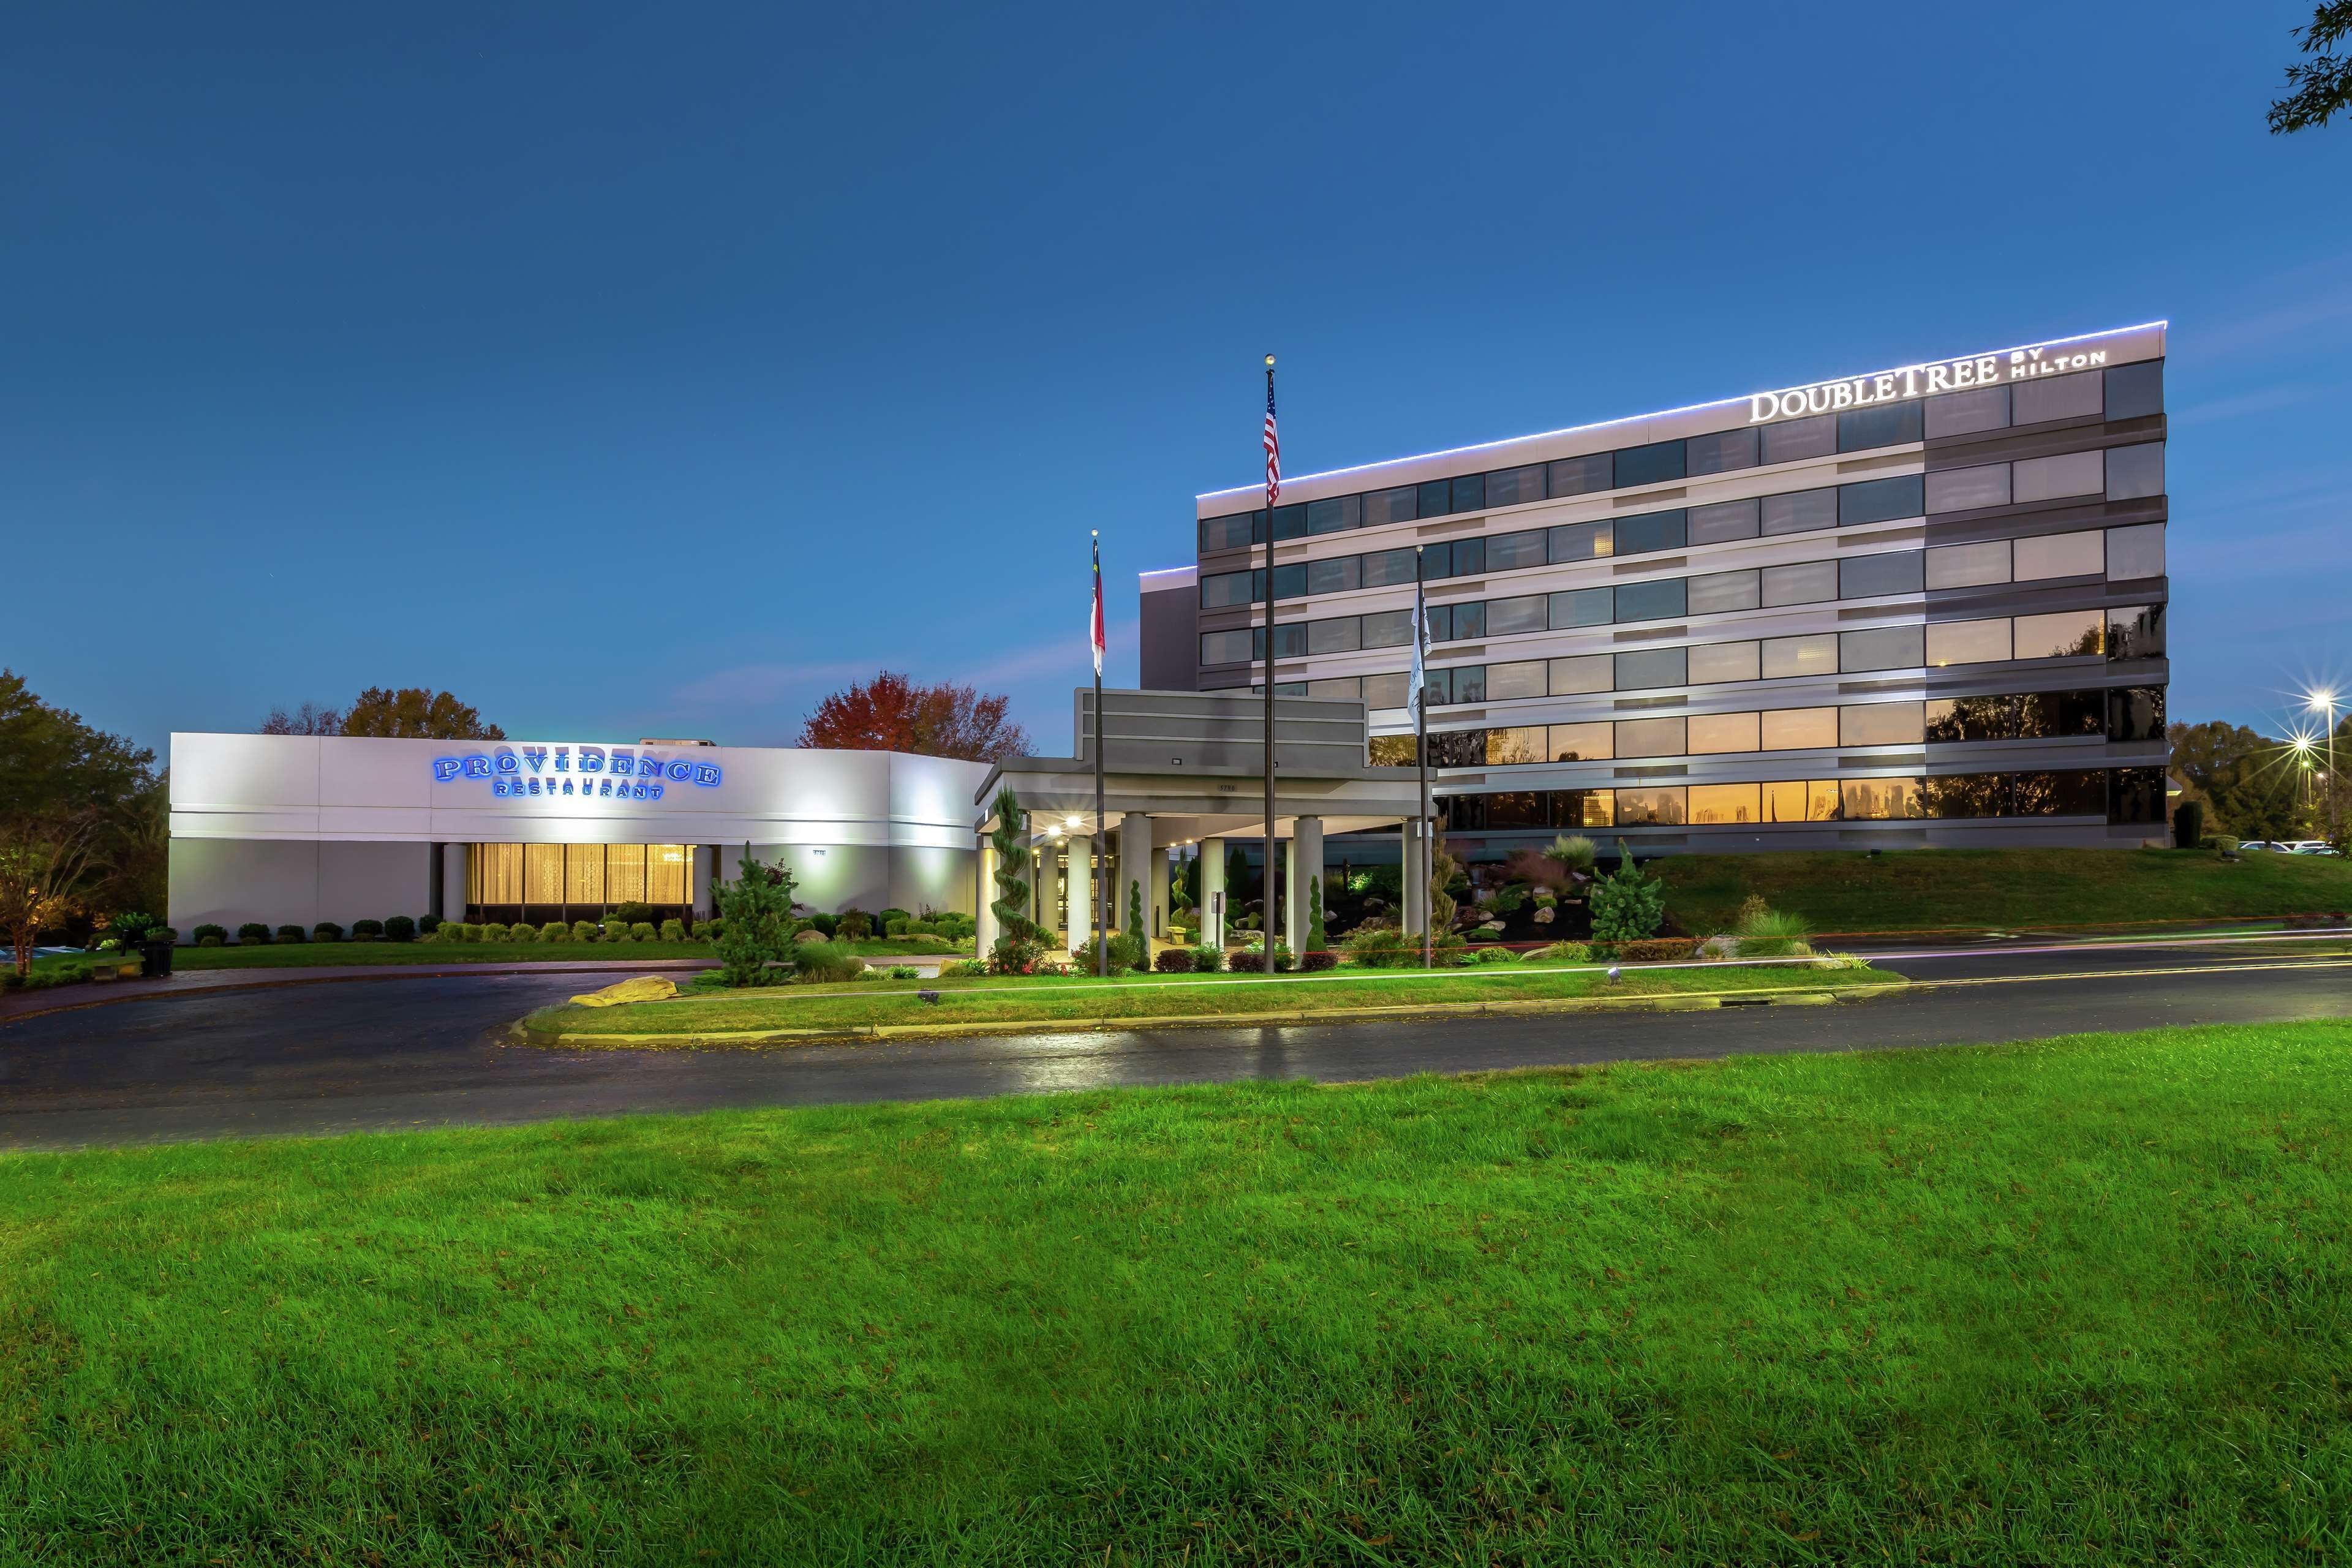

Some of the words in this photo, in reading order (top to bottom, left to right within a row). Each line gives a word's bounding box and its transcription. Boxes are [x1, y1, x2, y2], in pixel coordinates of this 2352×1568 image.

[2011, 347, 2043, 364] BY
[2011, 351, 2106, 379] HILTON
[435, 754, 720, 786] PROVIDENCE
[495, 783, 661, 799] RESTAURANT
